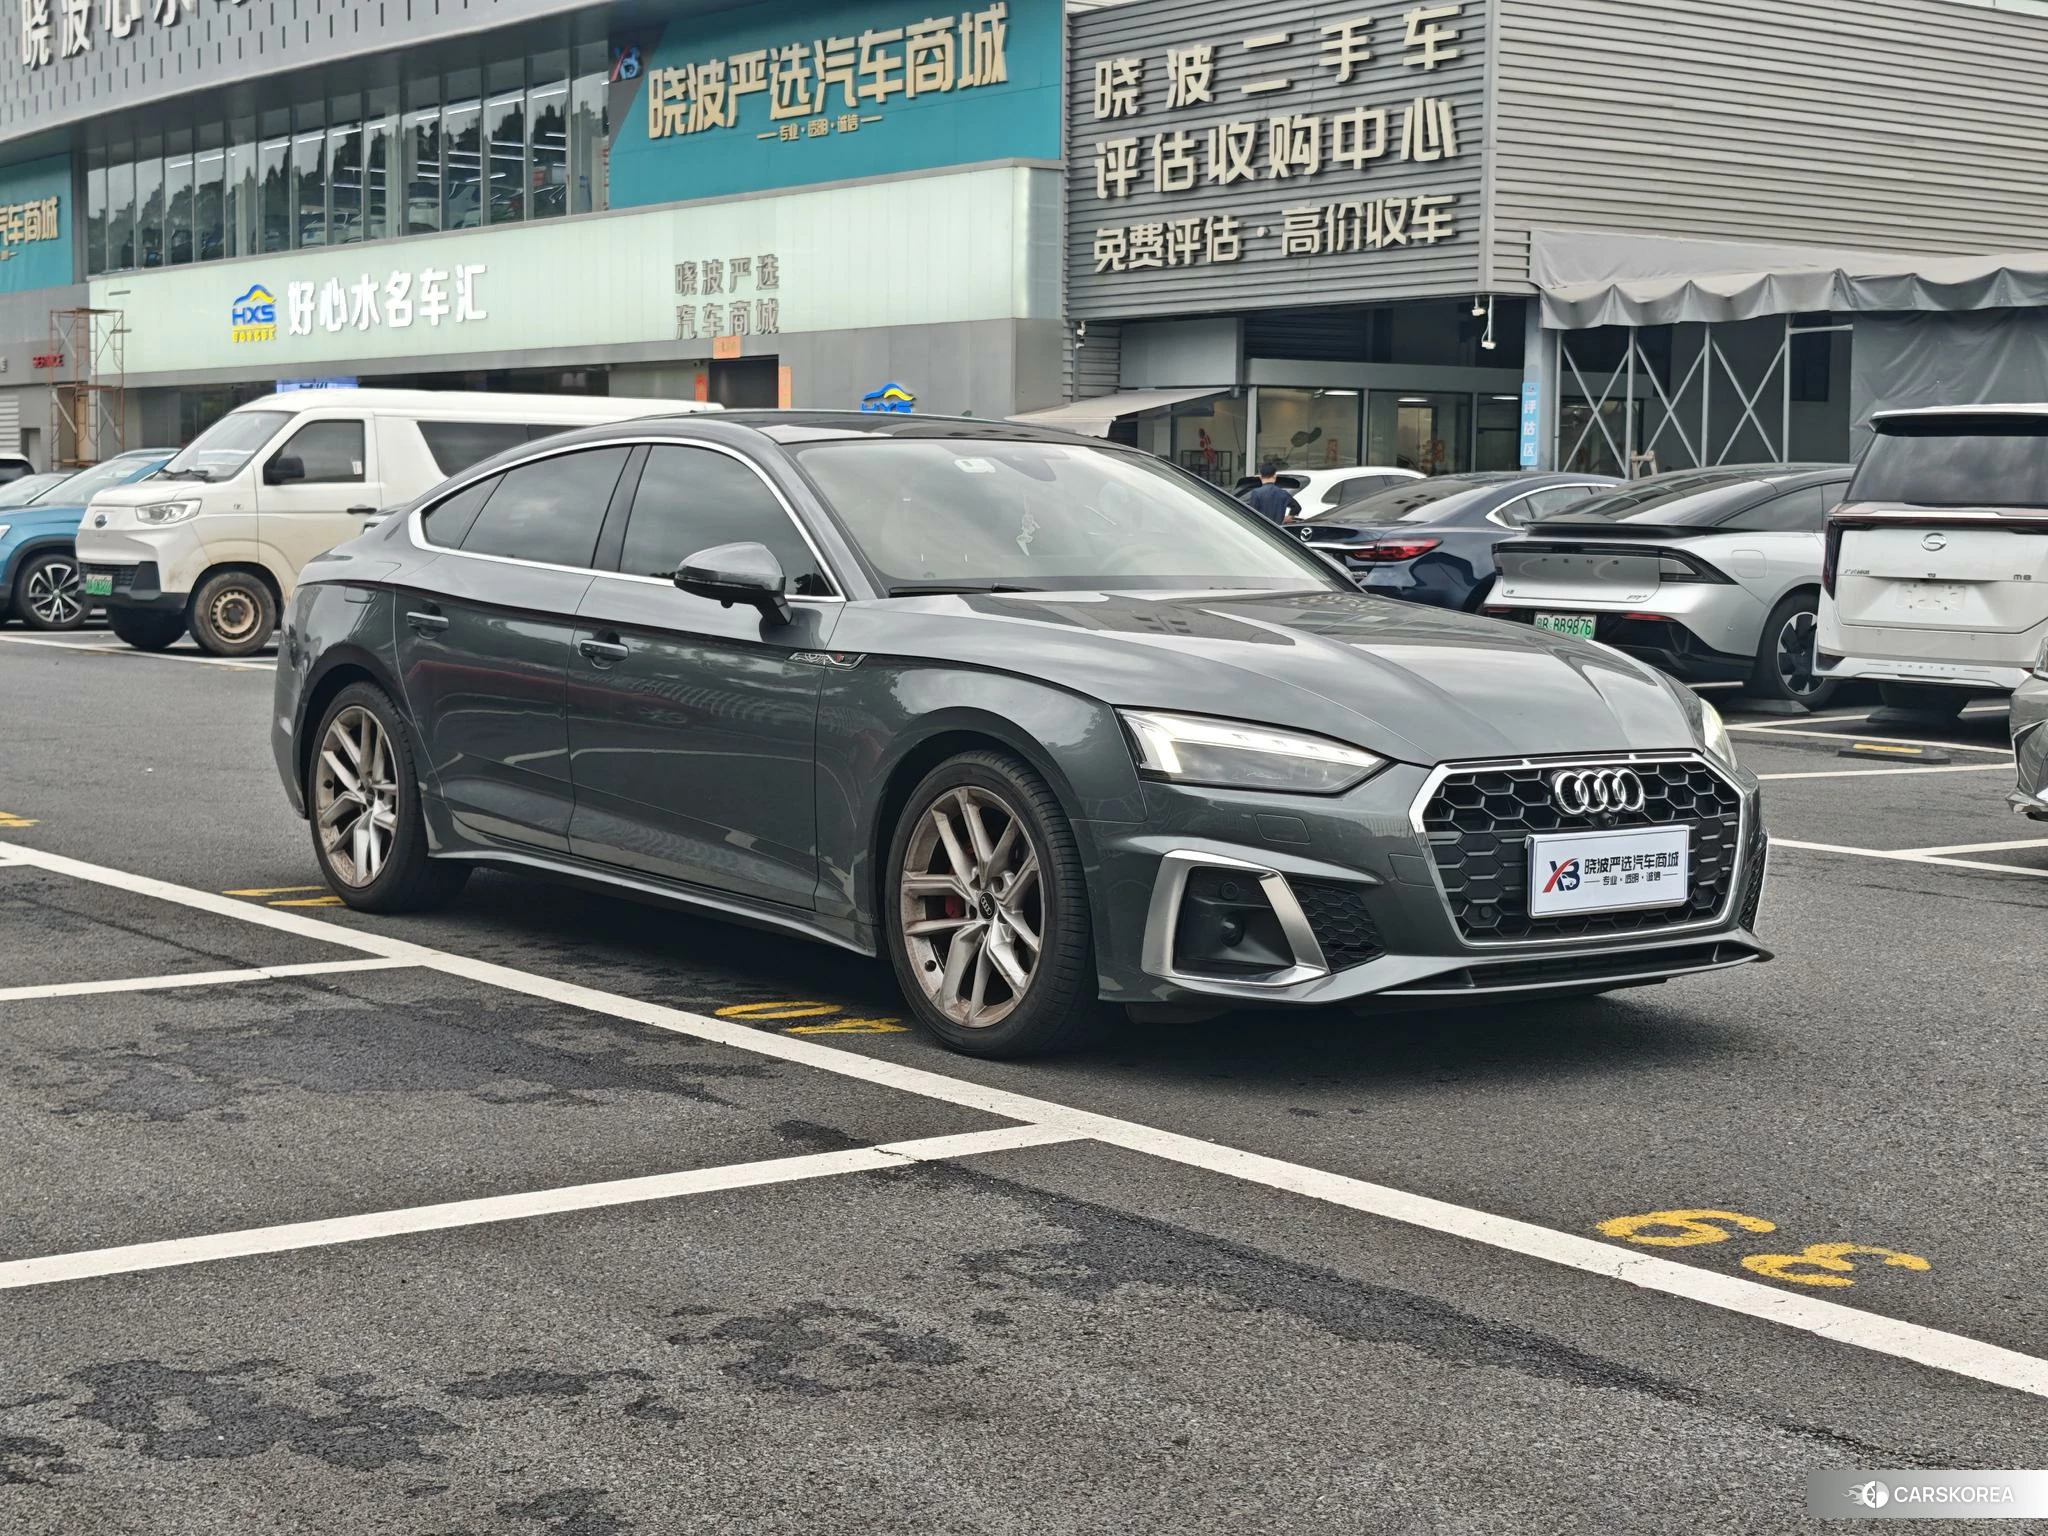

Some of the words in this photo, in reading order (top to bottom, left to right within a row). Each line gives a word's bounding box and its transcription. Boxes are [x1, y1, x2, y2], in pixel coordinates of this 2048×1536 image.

[648, 4, 1009, 139] 晓波严选汽车商城
[1094, 5, 1462, 119] 晓波二手车
[1095, 97, 1459, 199] 评估收购中心
[288, 264, 488, 336] 好心水名车汇
[675, 254, 779, 296] 晓波严选
[232, 304, 276, 326] HXS
[676, 298, 779, 340] 汽车商城
[1584, 851, 1679, 875] 晓波严选汽车商城
